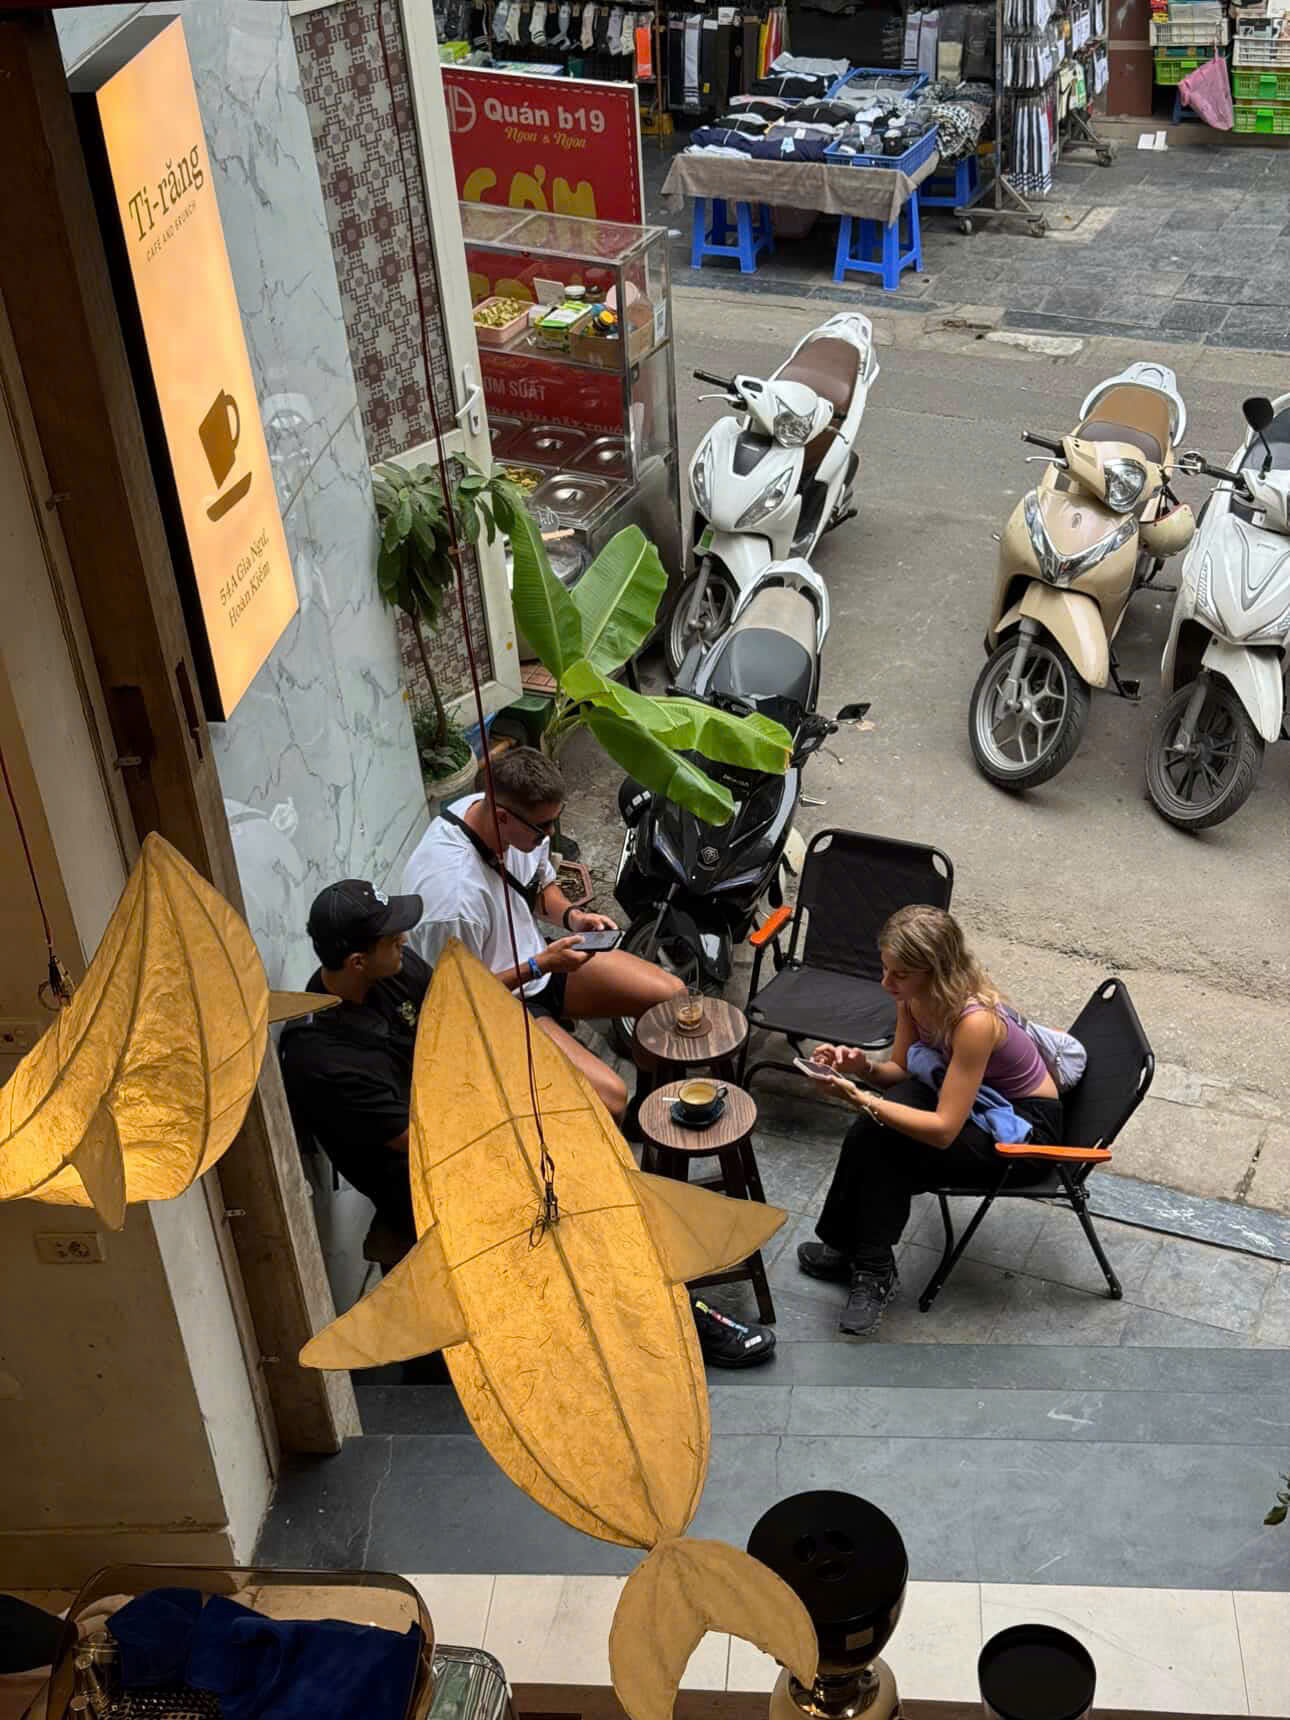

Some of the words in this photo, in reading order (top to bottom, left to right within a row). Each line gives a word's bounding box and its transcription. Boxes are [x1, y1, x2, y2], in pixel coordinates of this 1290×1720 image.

[484, 97, 550, 127] Quán
[557, 106, 606, 133] b19
[504, 127, 537, 144] Ngon
[553, 131, 586, 150] Ngon
[128, 144, 204, 242] Ti-răng
